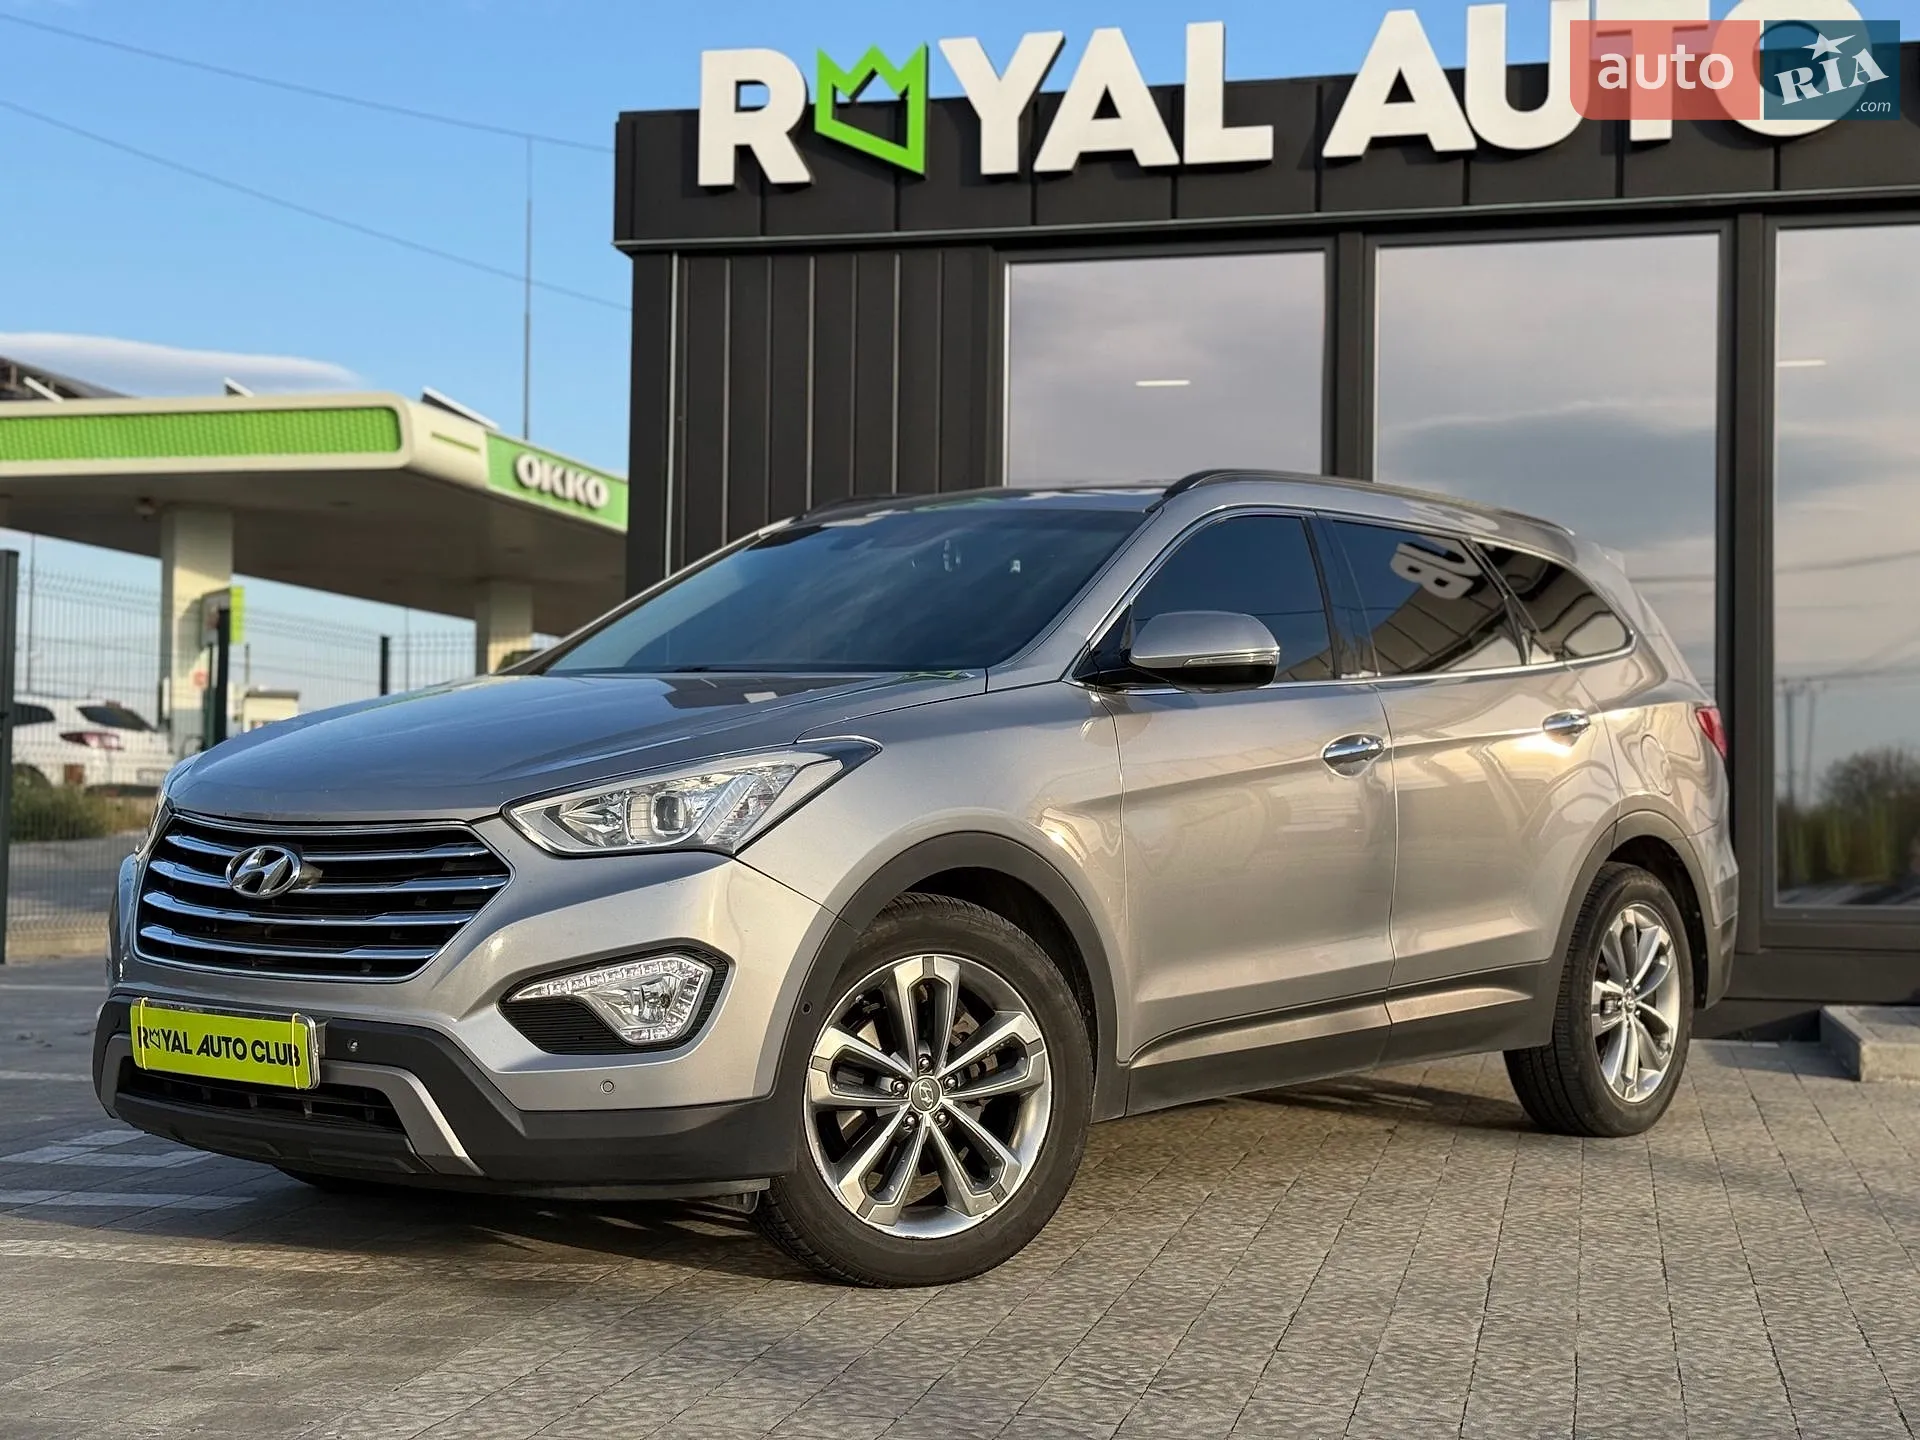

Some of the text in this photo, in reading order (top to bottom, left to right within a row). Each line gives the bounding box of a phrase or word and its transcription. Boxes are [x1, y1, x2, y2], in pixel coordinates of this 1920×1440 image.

[1322, 0, 1868, 157] AUTO
[515, 453, 609, 508] OKKO
[196, 1034, 248, 1061] AUTO
[251, 1039, 301, 1067] CLUB
